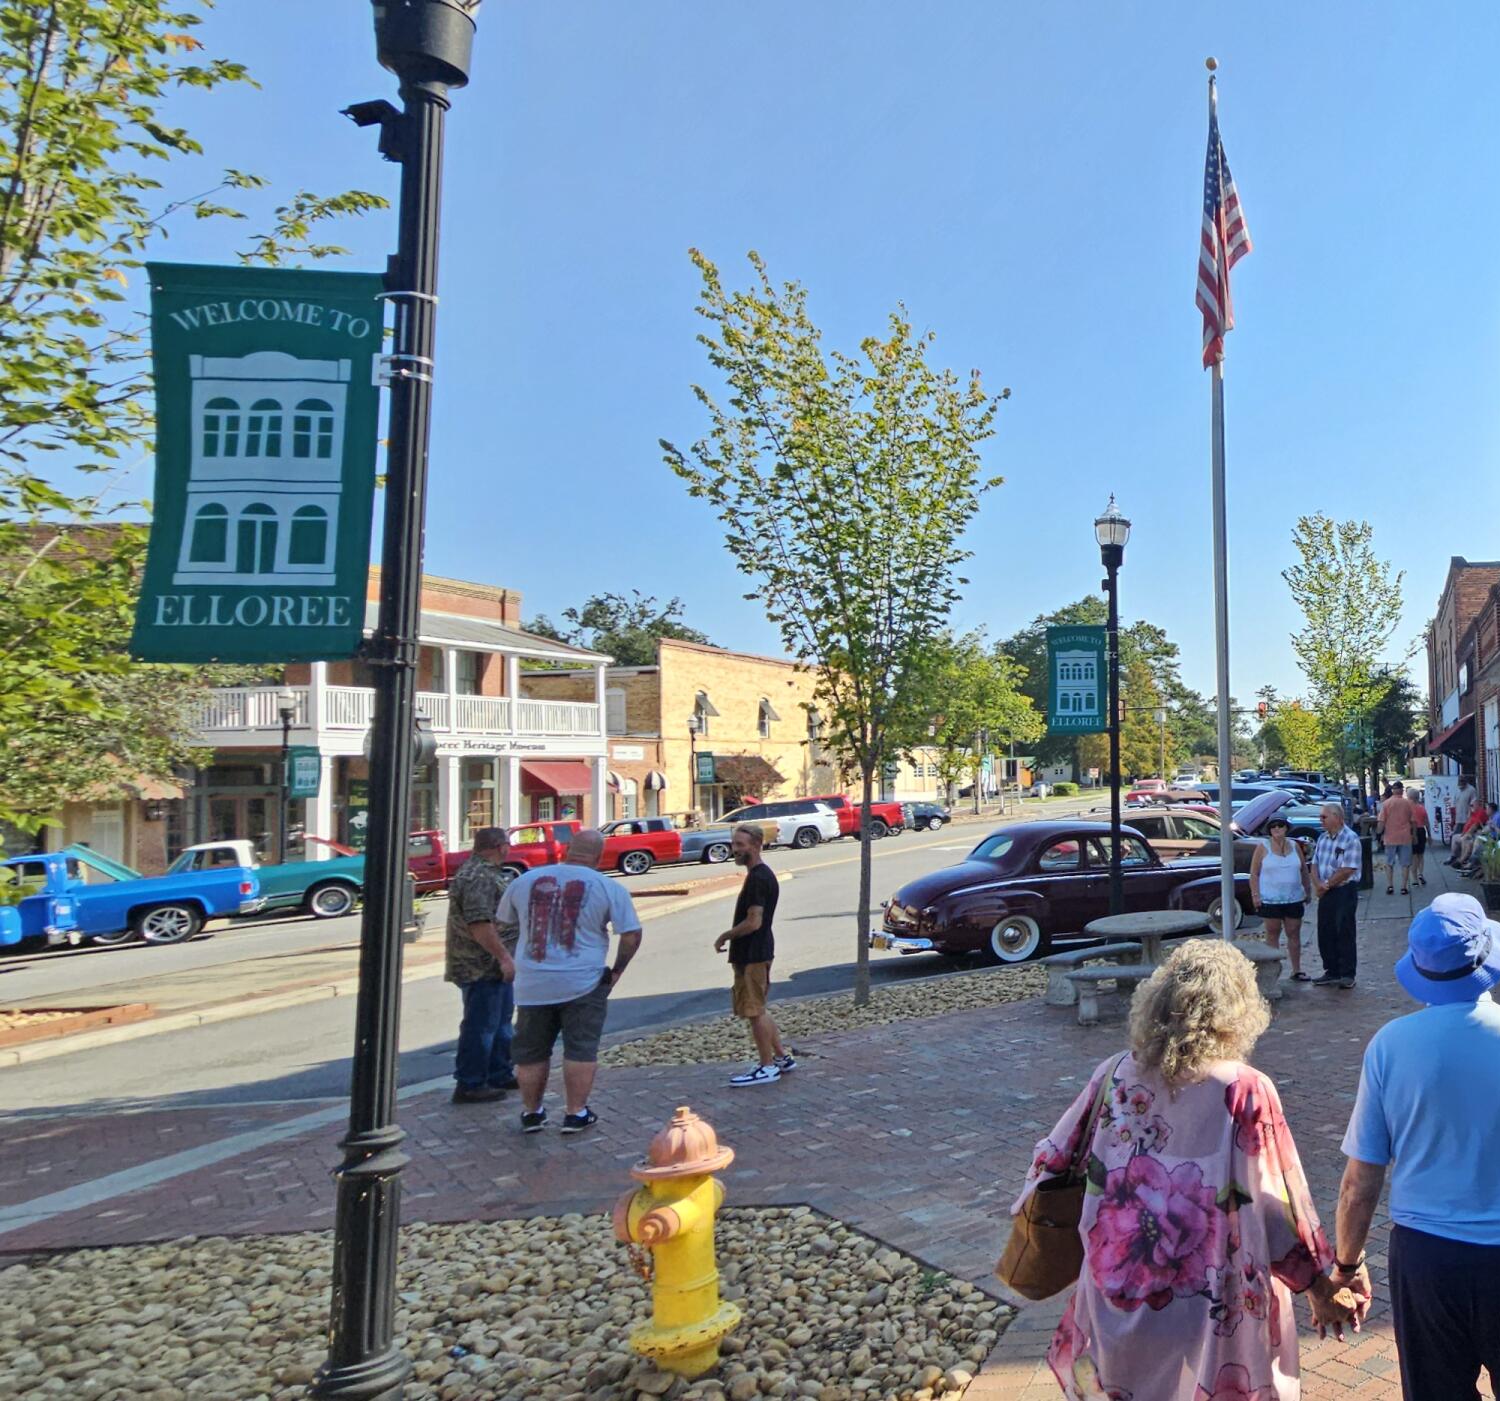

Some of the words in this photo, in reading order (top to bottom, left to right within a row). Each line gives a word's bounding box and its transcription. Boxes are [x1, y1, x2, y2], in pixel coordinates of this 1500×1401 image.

[169, 299, 324, 331] WELCOME
[328, 309, 371, 338] TO
[152, 594, 351, 627] ELLOREE
[1051, 716, 1102, 727] ELLOREE
